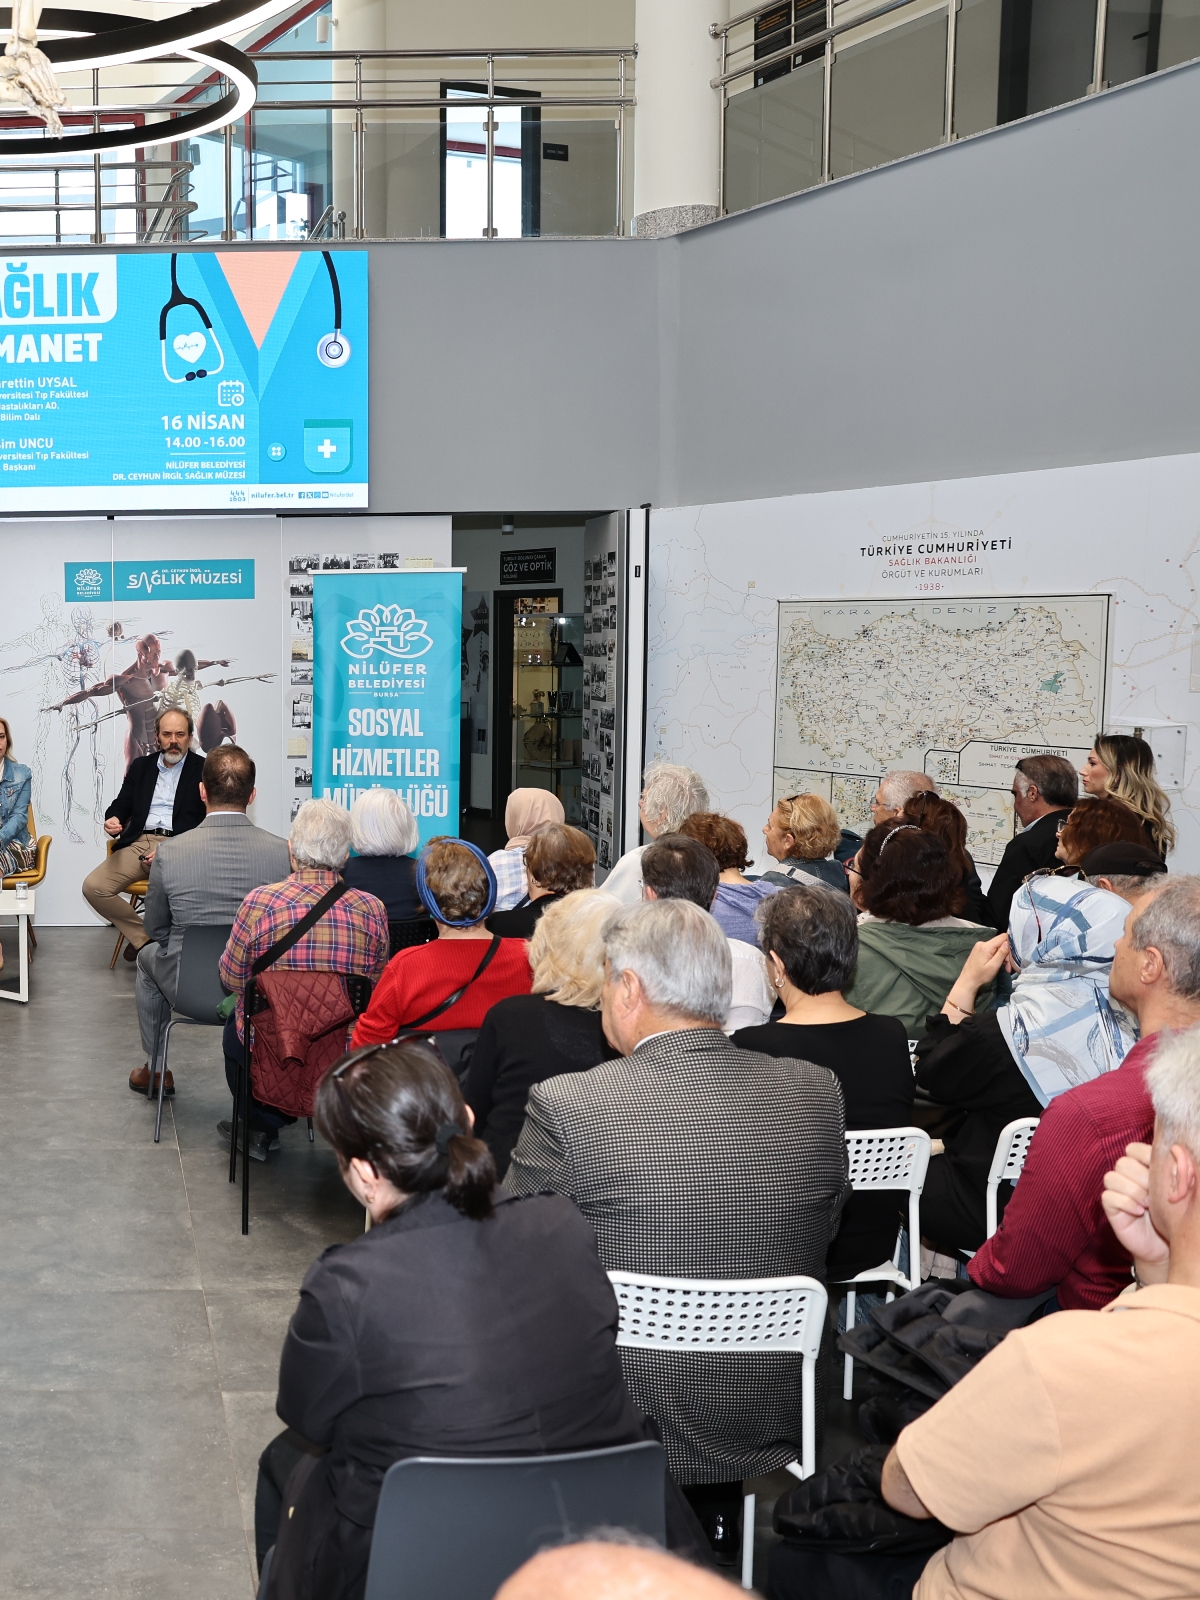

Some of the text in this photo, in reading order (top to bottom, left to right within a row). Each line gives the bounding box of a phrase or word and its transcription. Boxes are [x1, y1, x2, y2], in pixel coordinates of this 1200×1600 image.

[37, 376, 78, 388] UYSAL
[35, 391, 48, 401] Tıp
[50, 389, 89, 399] Fakültesi
[45, 401, 60, 410] AD.
[0, 413, 22, 421] Bilim
[24, 412, 40, 421] Dalı
[161, 411, 245, 430] 16 NİSAN
[19, 438, 54, 449] UNCU
[165, 436, 201, 448] 14.00
[36, 452, 49, 461] Tıp
[50, 450, 89, 460] Fakültesi
[3, 462, 36, 472] Başkanı
[166, 459, 246, 470] NİLÜFER BELEDİYESİ
[112, 470, 246, 481] DR. CEYHUN İRGİL SAĞLIK MÜZESİ
[251, 491, 294, 499] nilufer.bel.tr
[882, 532, 938, 543] CUMHURİYETİN
[952, 529, 984, 538] YILINDA
[860, 536, 1013, 557] TÜRKİYE CUMHURİYETİ
[503, 559, 552, 572] GÖZ VE OPTİK
[888, 554, 977, 567] SAĞLIK BAKANLIĞI
[881, 569, 912, 579] ÖRGÜT
[928, 567, 983, 577] KURUMLARI
[127, 569, 242, 593] SAĞLIK MÜZESİ
[932, 606, 997, 615] DENİZ
[348, 661, 427, 675] NİLÜFER
[348, 677, 425, 689] BELEDİYESİ
[348, 708, 424, 737] SOSYAL
[990, 744, 1017, 754] TÜRKİYE
[332, 744, 440, 777] HİZMETLER
[808, 759, 888, 773] AKDENİZ
